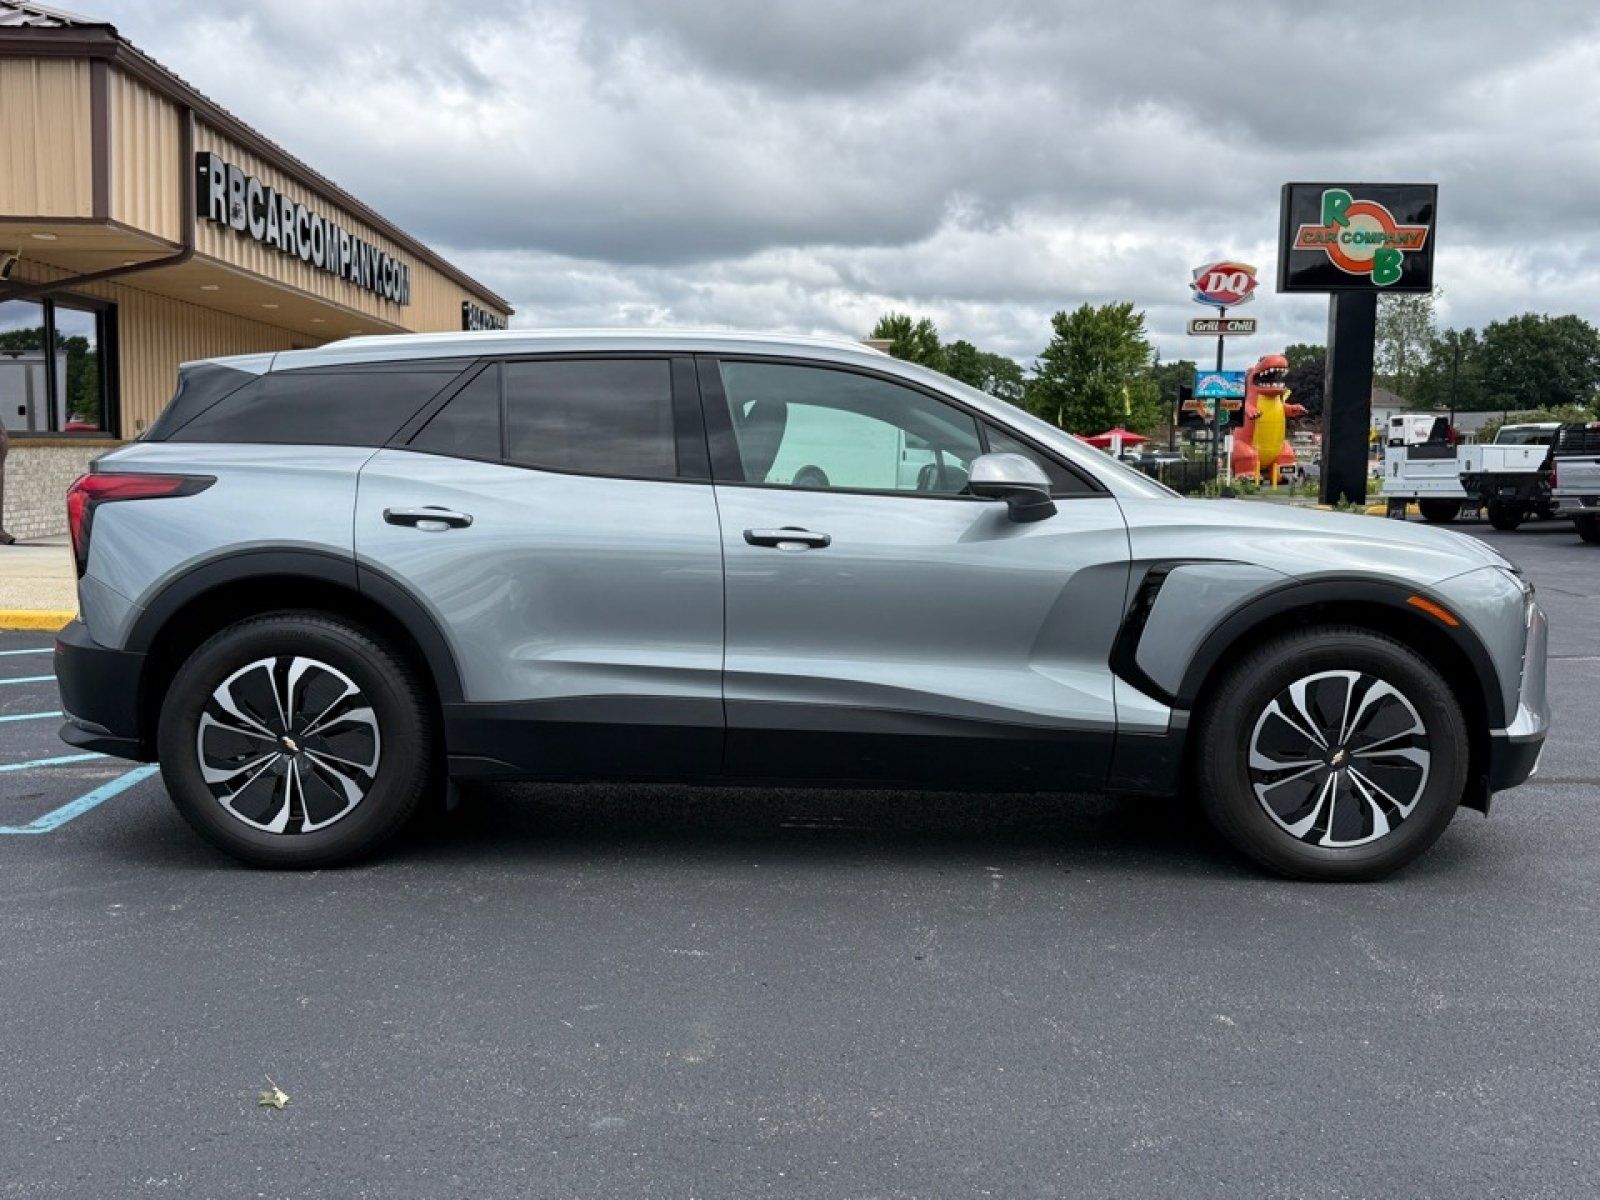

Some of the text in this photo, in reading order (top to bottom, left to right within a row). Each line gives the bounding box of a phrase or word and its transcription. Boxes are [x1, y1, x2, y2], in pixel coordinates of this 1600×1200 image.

[1323, 189, 1351, 227] R
[200, 151, 410, 306] RBCARCOMPANY.COM
[1303, 231, 1421, 244] CAR COMPANY
[1372, 248, 1402, 285] B
[1205, 272, 1248, 295] DQ
[1194, 321, 1219, 331] Grill
[1227, 321, 1253, 331] Chill
